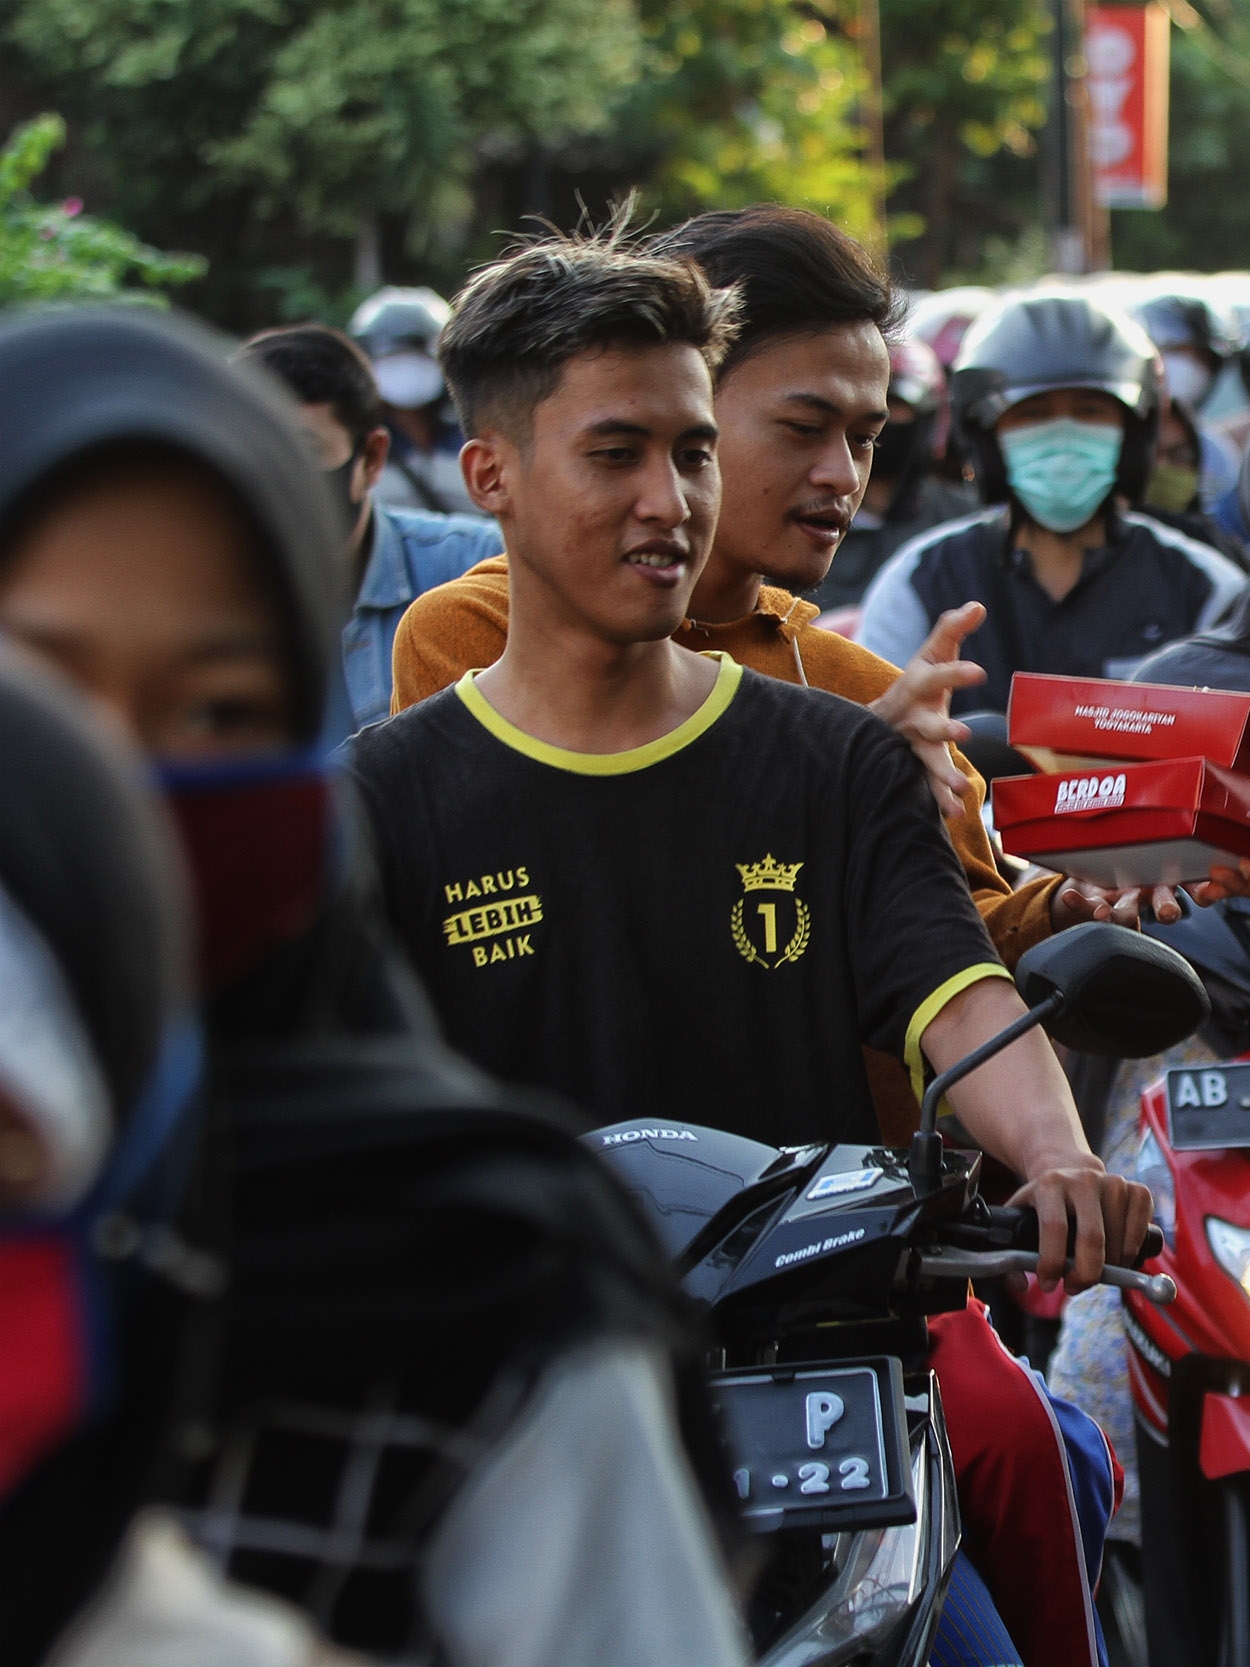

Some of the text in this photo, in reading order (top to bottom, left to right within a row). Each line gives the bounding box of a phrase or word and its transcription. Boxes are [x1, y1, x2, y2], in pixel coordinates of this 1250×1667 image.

[1075, 705, 1110, 720] MASJID
[1094, 718, 1152, 735] YOGYAKARTA
[1056, 773, 1126, 803] BERDOA
[445, 867, 530, 904] HARUS
[454, 901, 536, 940] LEBIH
[756, 902, 778, 953] 1
[472, 934, 535, 968] BAIK
[1177, 1070, 1228, 1108] AB
[601, 1127, 698, 1146] HONDA
[775, 1228, 865, 1269] Combi Brake
[805, 1391, 845, 1449] P
